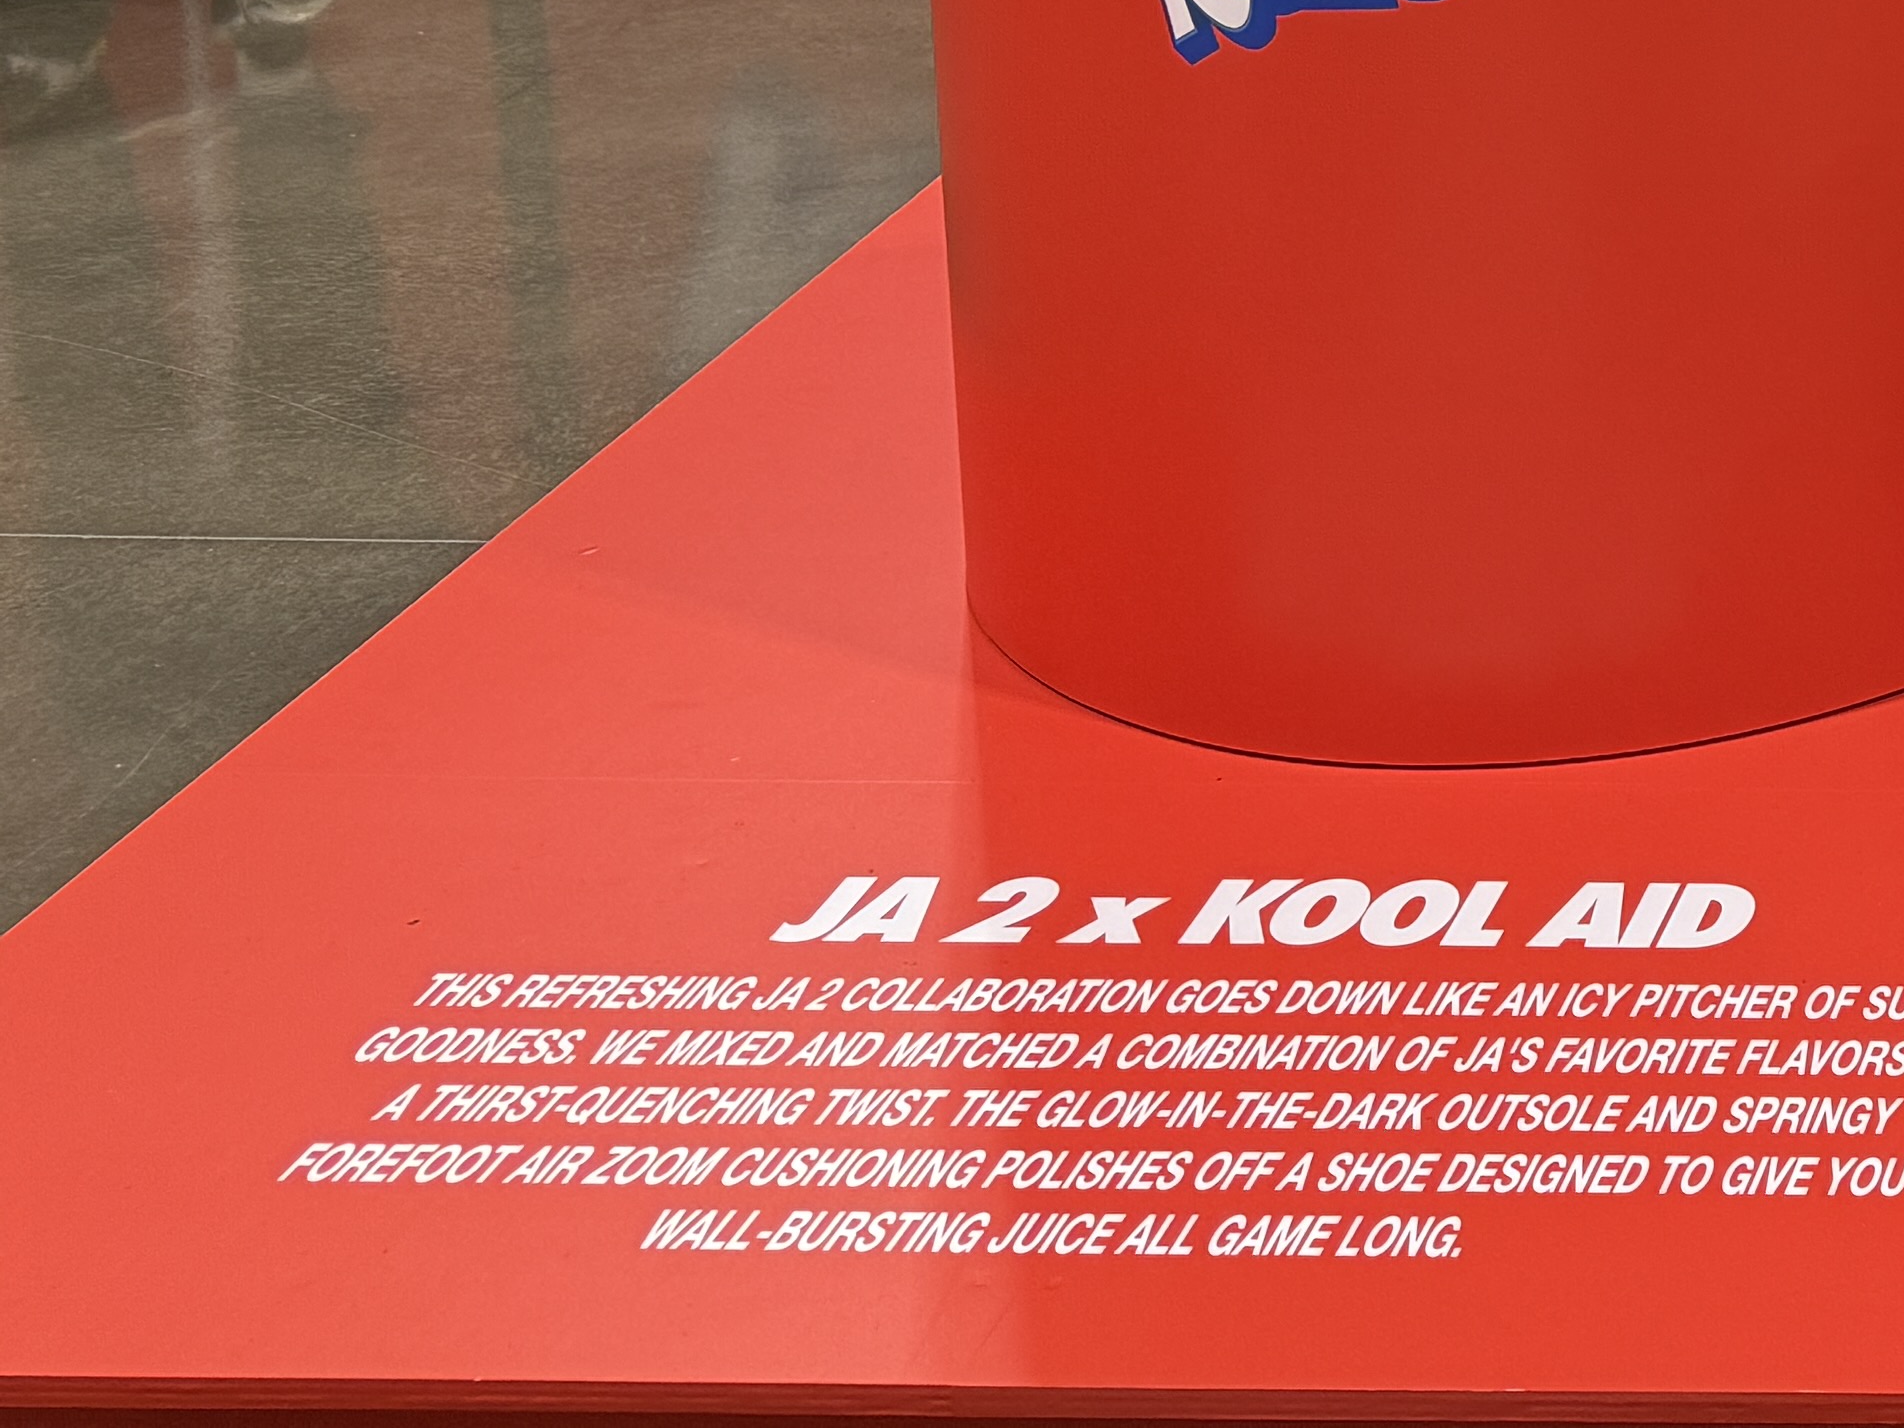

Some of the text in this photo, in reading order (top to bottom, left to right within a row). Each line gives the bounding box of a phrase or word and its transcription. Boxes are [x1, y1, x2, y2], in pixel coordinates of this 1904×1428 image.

[768, 876, 1756, 949] JA 2 x KOOL AID
[413, 972, 515, 1008] THIS
[501, 973, 759, 1011] REFRESHING
[751, 976, 812, 1011] JA
[803, 977, 845, 1011] 2
[840, 976, 1169, 1013] COLLABORATION
[1165, 979, 1279, 1014] GOES
[1275, 980, 1407, 1015] DOWN
[1402, 981, 1499, 1017] LIKE
[1492, 982, 1560, 1017] AN
[1557, 982, 1634, 1018] ICY
[1629, 983, 1799, 1019] PITCHER
[1804, 985, 1862, 1020] OF
[354, 1025, 587, 1065] GOODNESS.
[589, 1029, 671, 1066] WE
[654, 1029, 795, 1067] MIXED
[784, 1031, 886, 1067] AND
[878, 1031, 1080, 1069] MATCHED
[1073, 1033, 1114, 1069] A
[1116, 1033, 1396, 1071] COMBINATION
[1395, 1035, 1459, 1072] OF
[1453, 1036, 1545, 1073] JA'S
[1544, 1037, 1737, 1075] FAVORITE
[370, 1083, 1904, 1135] A THIRST-QUENCHING TWIST. THE GLOW-IN-THE-DARK OUTSOLE AND SPRINGY
[277, 1142, 525, 1184] FOREFOOT
[510, 1144, 595, 1185] AIR
[592, 1145, 731, 1186] ZOOM
[721, 1146, 987, 1189] CUSHIONING
[981, 1149, 1194, 1191] POLISHES
[1193, 1151, 1286, 1191] OFF
[1275, 1151, 1314, 1192] A
[1317, 1151, 1442, 1193] SHOE
[1436, 1153, 1650, 1194] DESIGNED
[1658, 1155, 1715, 1195] TO
[1721, 1155, 1813, 1196] GIVE
[639, 1208, 1462, 1258] WALL-BURSTING JUICE ALL GAME LONG.
